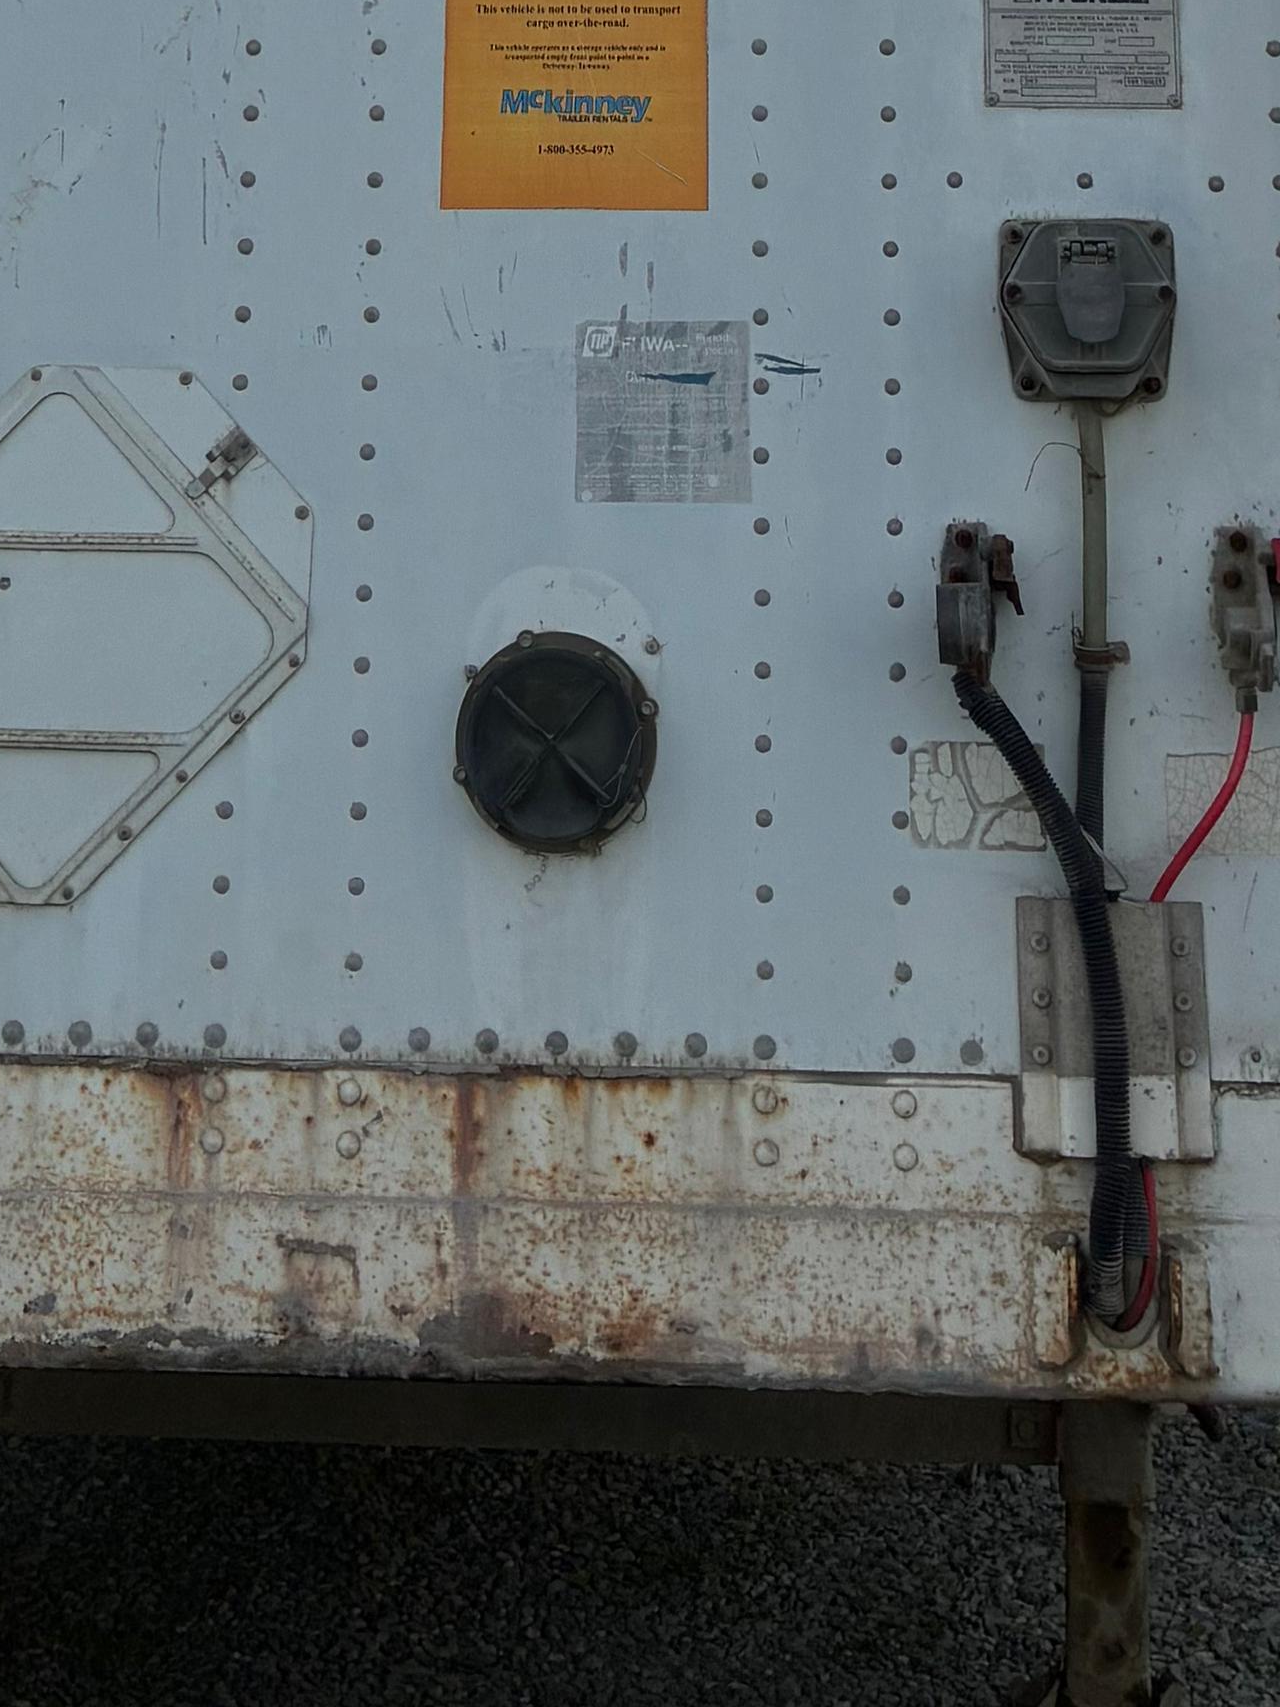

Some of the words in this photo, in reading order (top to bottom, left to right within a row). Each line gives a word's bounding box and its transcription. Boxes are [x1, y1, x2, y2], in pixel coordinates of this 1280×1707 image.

[476, 4, 497, 14] This
[500, 4, 535, 14] vehicle
[537, 4, 545, 14] is
[548, 5, 564, 14] not
[567, 5, 578, 14] to
[580, 4, 592, 14] be
[595, 5, 618, 14] used
[621, 5, 631, 14] to
[633, 5, 681, 16] transport
[526, 19, 555, 29] cargo
[557, 18, 629, 28] over-the-road.
[557, 115, 590, 123] TRAILER
[592, 115, 629, 123] RENTALS
[538, 144, 615, 156] 1-800-355-4973
